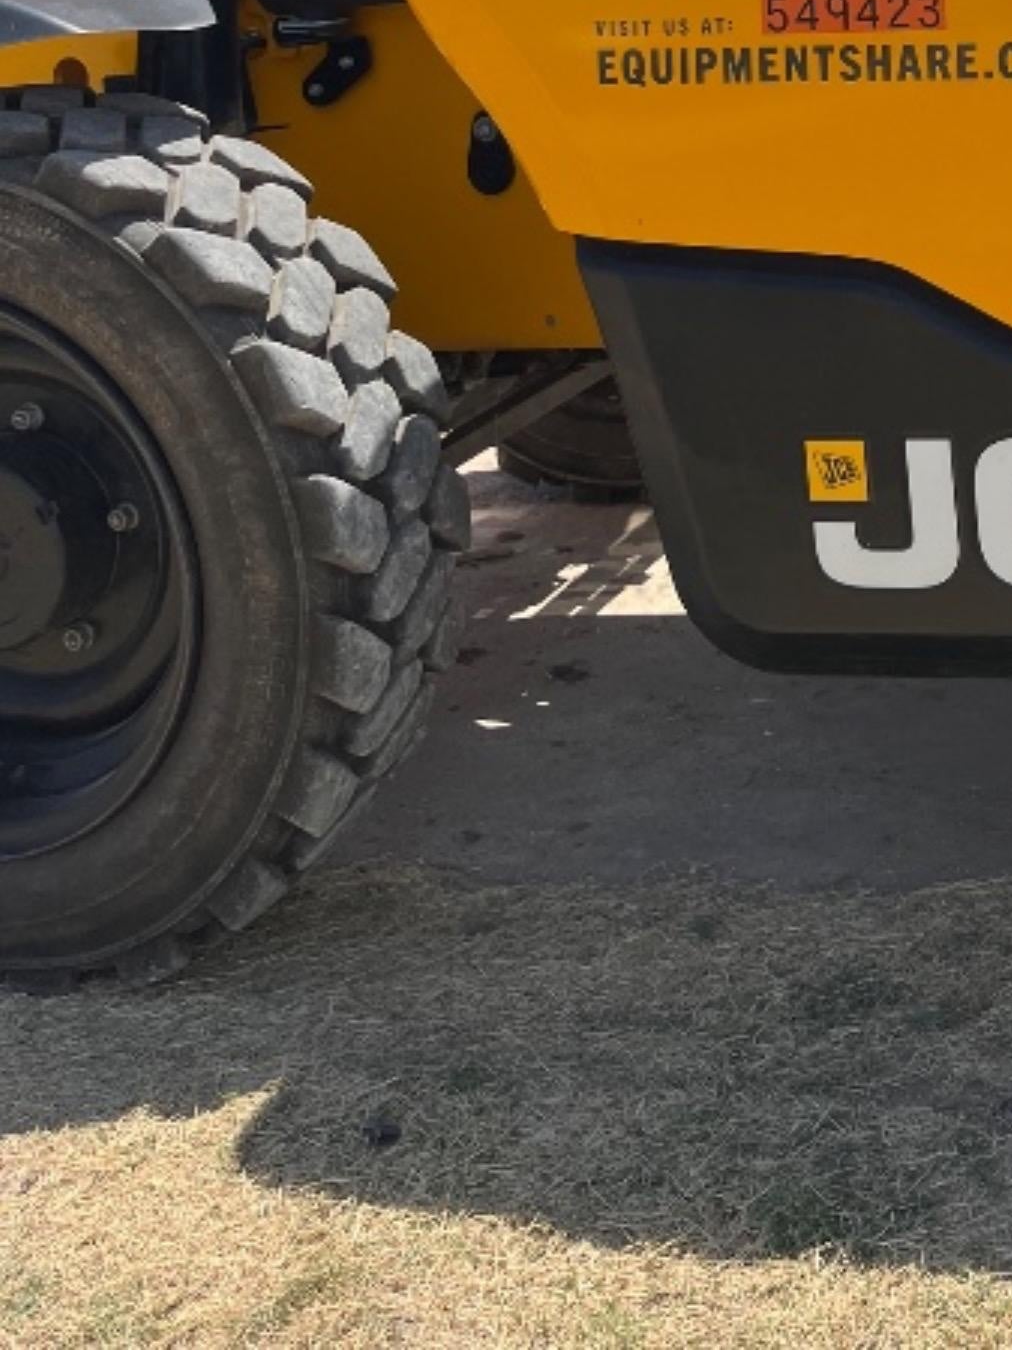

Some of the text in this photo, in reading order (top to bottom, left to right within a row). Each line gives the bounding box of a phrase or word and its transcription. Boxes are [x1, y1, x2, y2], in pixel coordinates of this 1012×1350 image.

[594, 17, 733, 37] VISIT US AT:
